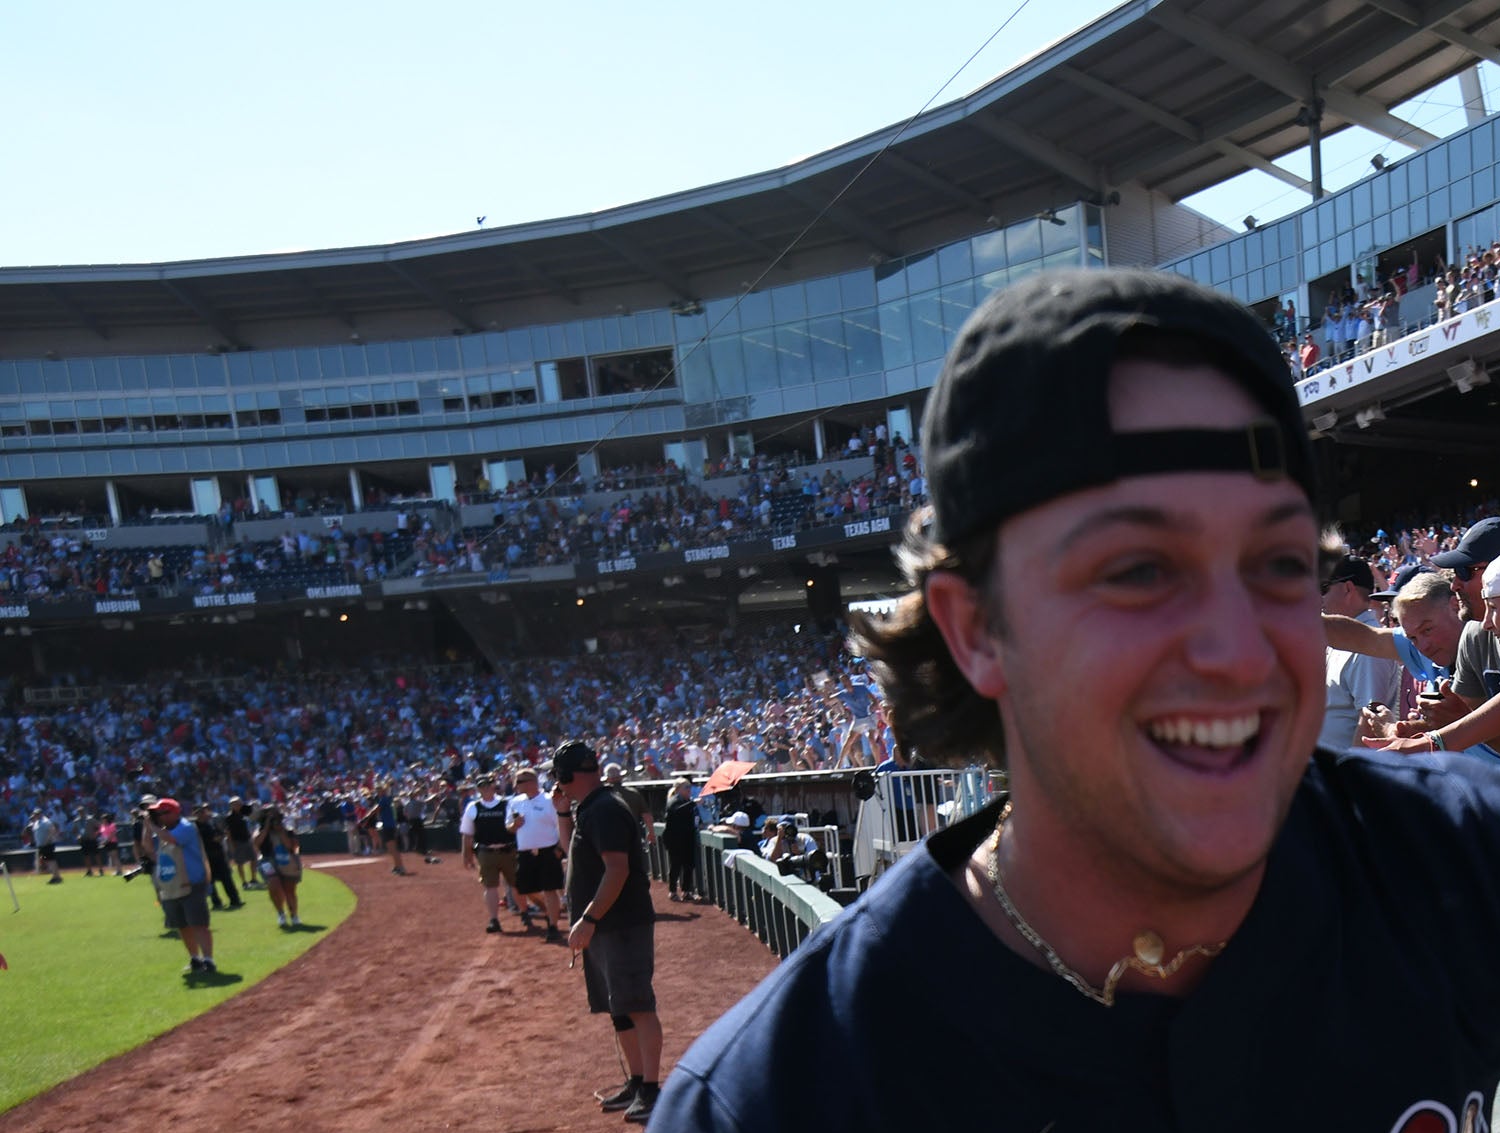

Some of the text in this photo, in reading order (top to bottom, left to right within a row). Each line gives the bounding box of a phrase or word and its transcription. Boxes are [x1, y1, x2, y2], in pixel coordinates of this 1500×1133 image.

[844, 516, 891, 538] TEXAS A&M
[771, 534, 797, 550] TEXAS
[685, 545, 730, 562] STANFORD
[194, 591, 257, 608] NOTRE DAME
[306, 584, 362, 599] OKLAHOMA
[96, 599, 141, 613] AUBURN
